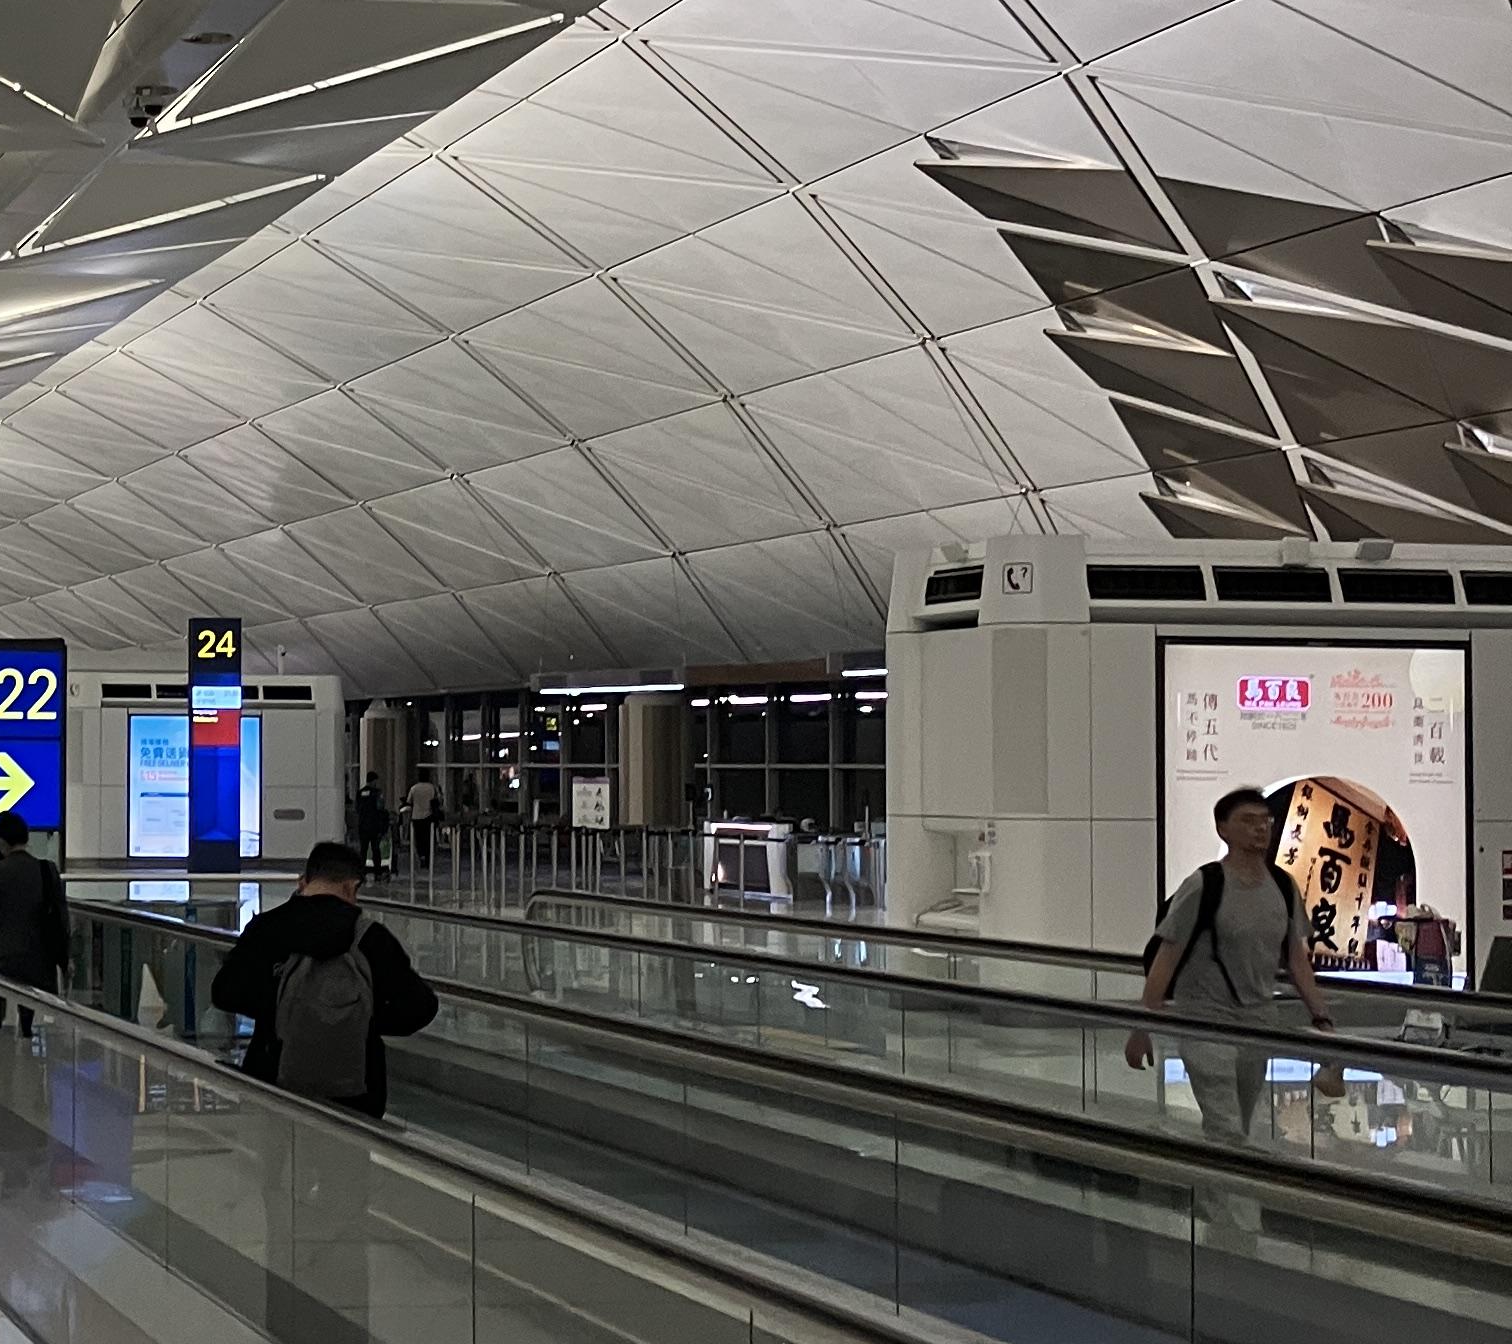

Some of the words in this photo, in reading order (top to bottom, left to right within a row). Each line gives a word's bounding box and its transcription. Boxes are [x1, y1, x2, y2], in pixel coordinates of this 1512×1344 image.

[197, 629, 236, 658] 24
[1361, 692, 1393, 709] 200
[1307, 803, 1355, 953] 馬百良
